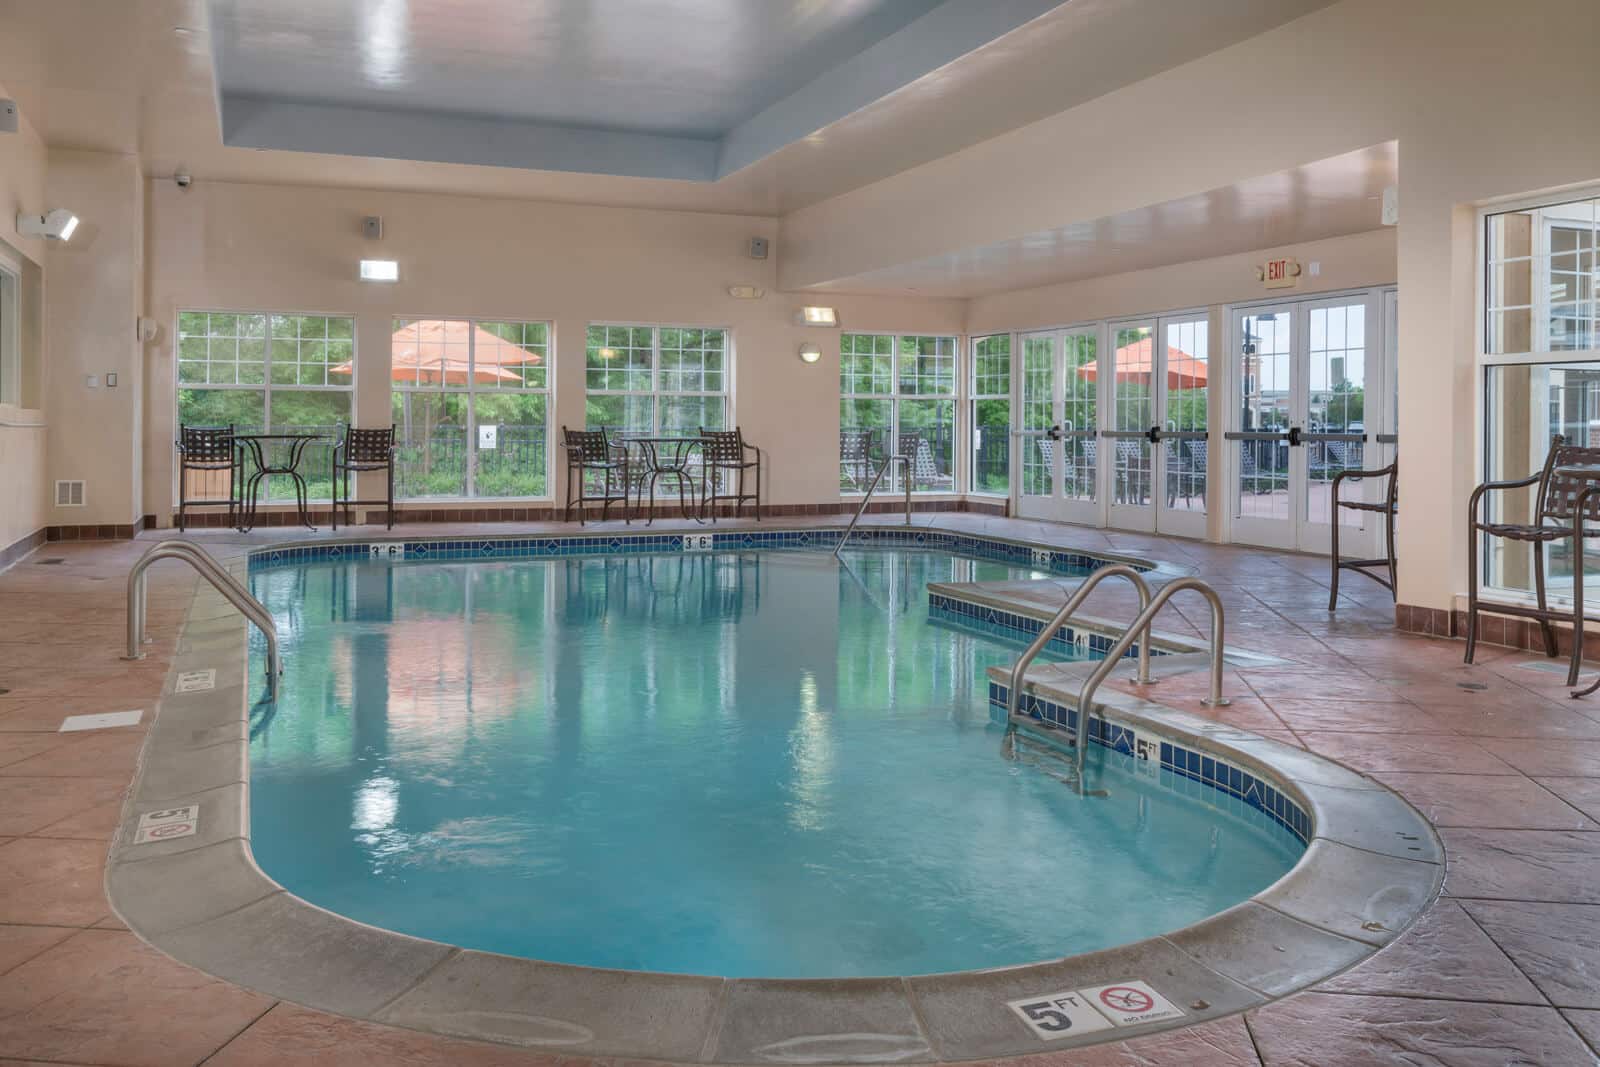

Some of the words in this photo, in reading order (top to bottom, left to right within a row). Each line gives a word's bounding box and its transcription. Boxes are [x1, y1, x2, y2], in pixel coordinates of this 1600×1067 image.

[1268, 260, 1286, 280] EXIT
[1137, 738, 1148, 760] 5
[1019, 1001, 1073, 1032] 5
[1053, 997, 1079, 1010] FT
